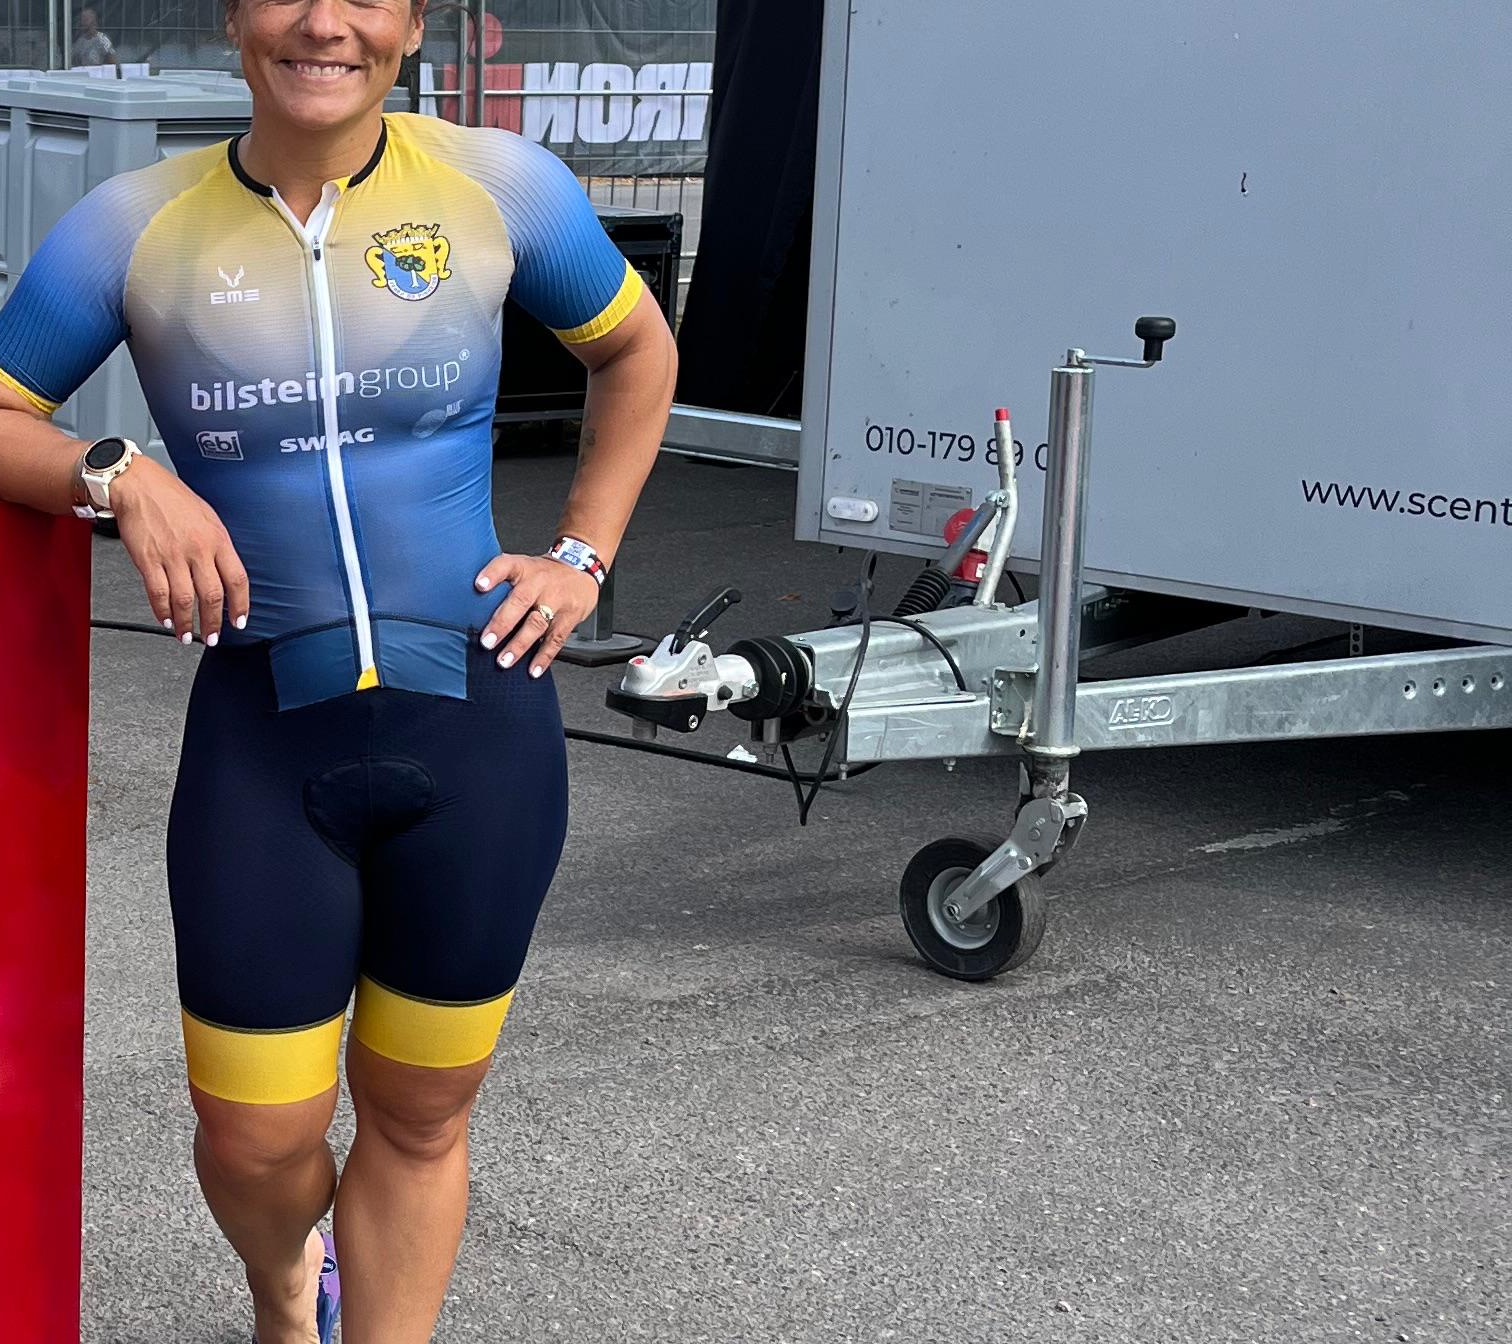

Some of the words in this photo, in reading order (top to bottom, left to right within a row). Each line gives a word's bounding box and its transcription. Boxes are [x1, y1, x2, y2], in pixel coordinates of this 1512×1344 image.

[210, 288, 260, 305] EME
[197, 432, 240, 457] febi
[279, 427, 375, 454] SWAG
[865, 425, 976, 462] 010-179
